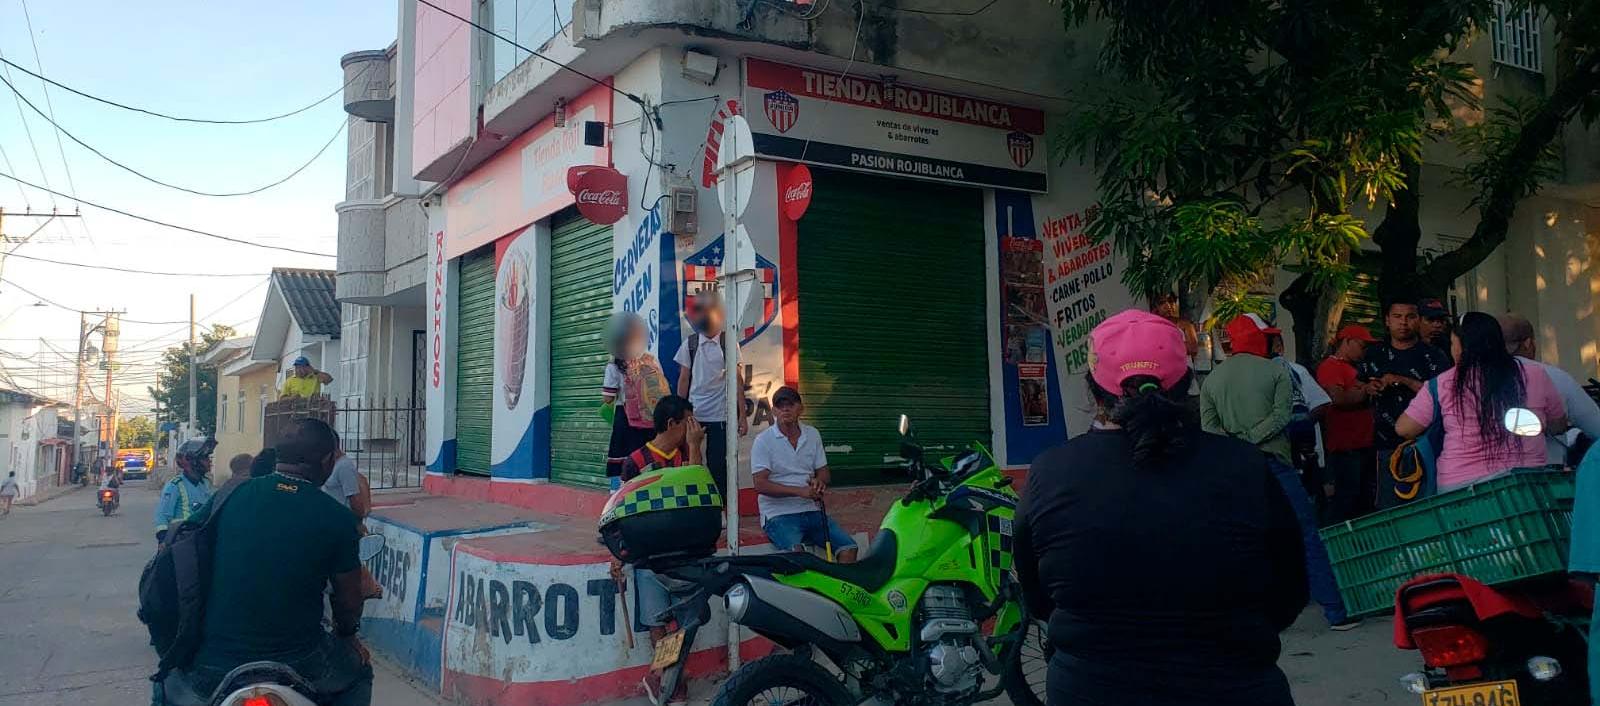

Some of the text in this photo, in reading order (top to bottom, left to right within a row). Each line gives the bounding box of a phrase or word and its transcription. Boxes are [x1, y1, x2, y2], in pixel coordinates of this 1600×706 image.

[802, 71, 1013, 126] TIENDA ROJIBLANCA
[876, 120, 901, 130] ventas
[851, 153, 964, 179] PASION ROJIBLANCA
[1043, 213, 1082, 239] VENTA
[614, 201, 662, 295] CERVEZAS
[1053, 233, 1094, 258] VIVER
[1058, 242, 1111, 277] ABARROTES
[1053, 263, 1113, 303] CARNE POLLO
[433, 230, 444, 388] RANCHOS
[1056, 293, 1096, 328] FRITOS
